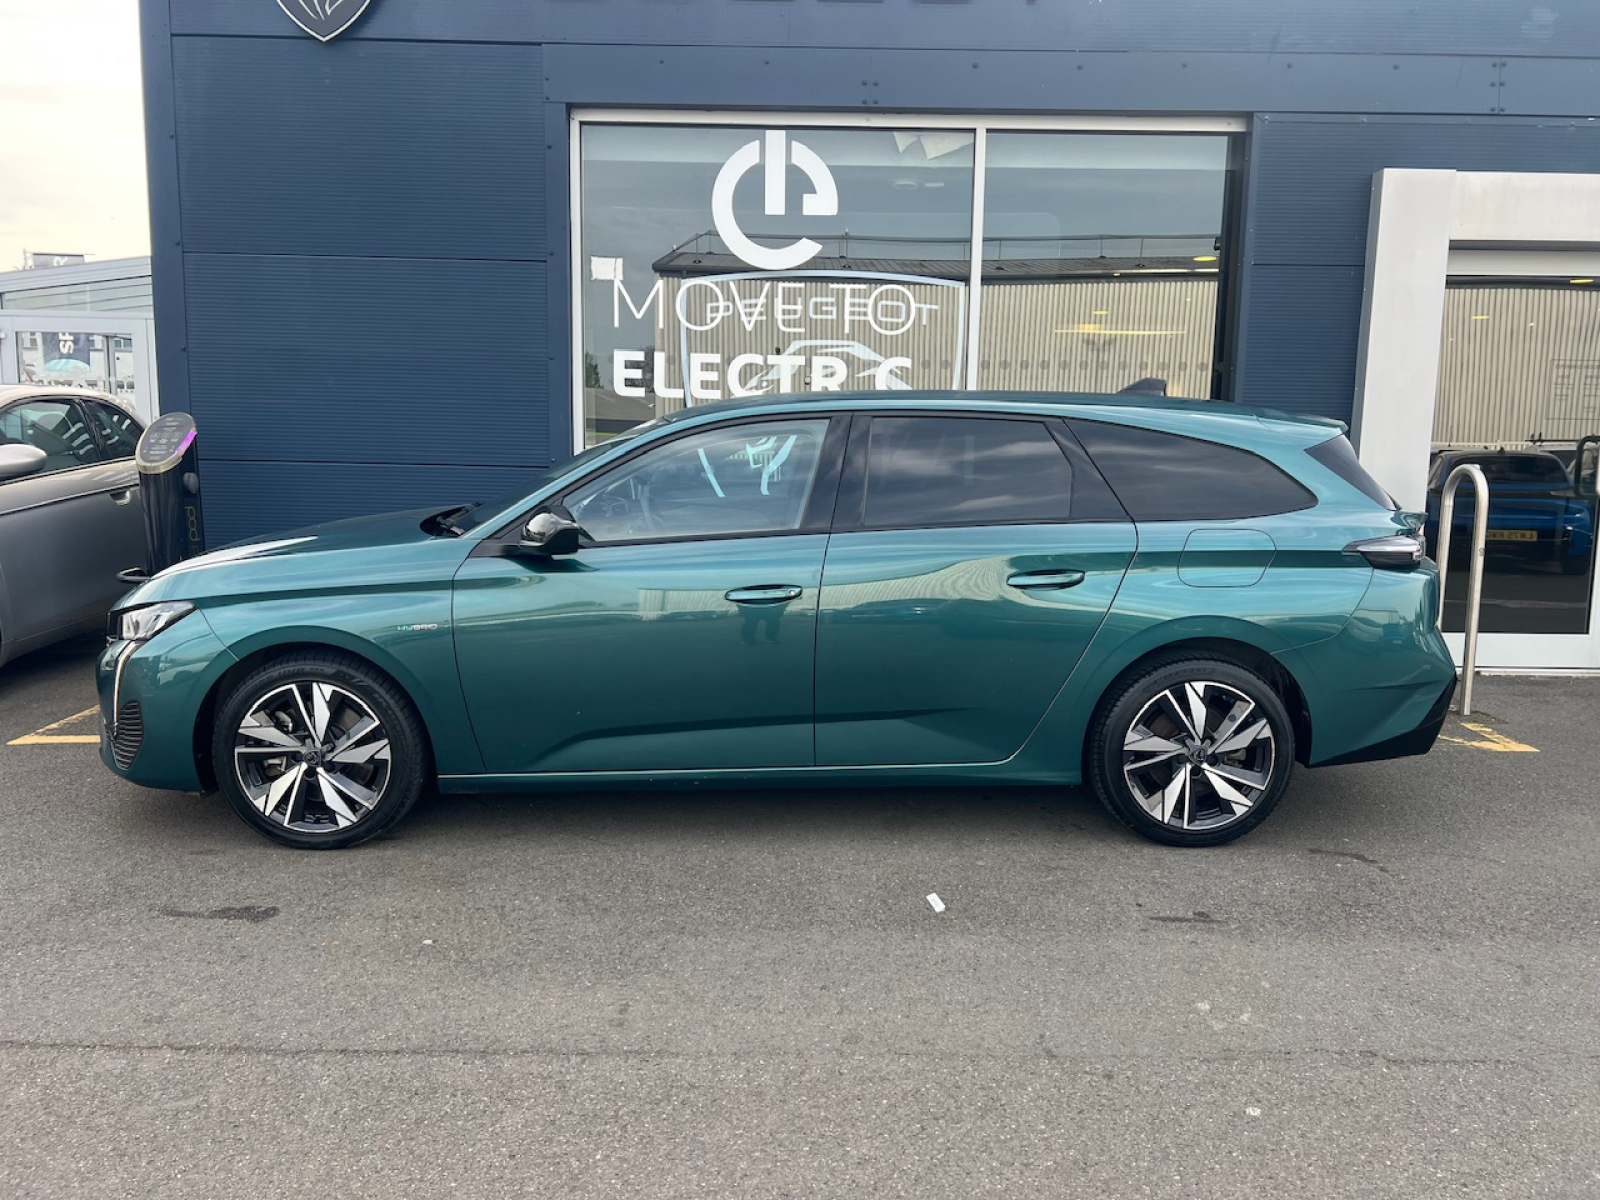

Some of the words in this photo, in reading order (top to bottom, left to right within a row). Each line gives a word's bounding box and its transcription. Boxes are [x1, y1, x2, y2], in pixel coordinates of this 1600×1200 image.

[613, 279, 805, 332] MOVE
[829, 282, 916, 336] TO
[706, 296, 939, 326] PEUGEOT
[613, 348, 912, 399] ELECTRC
